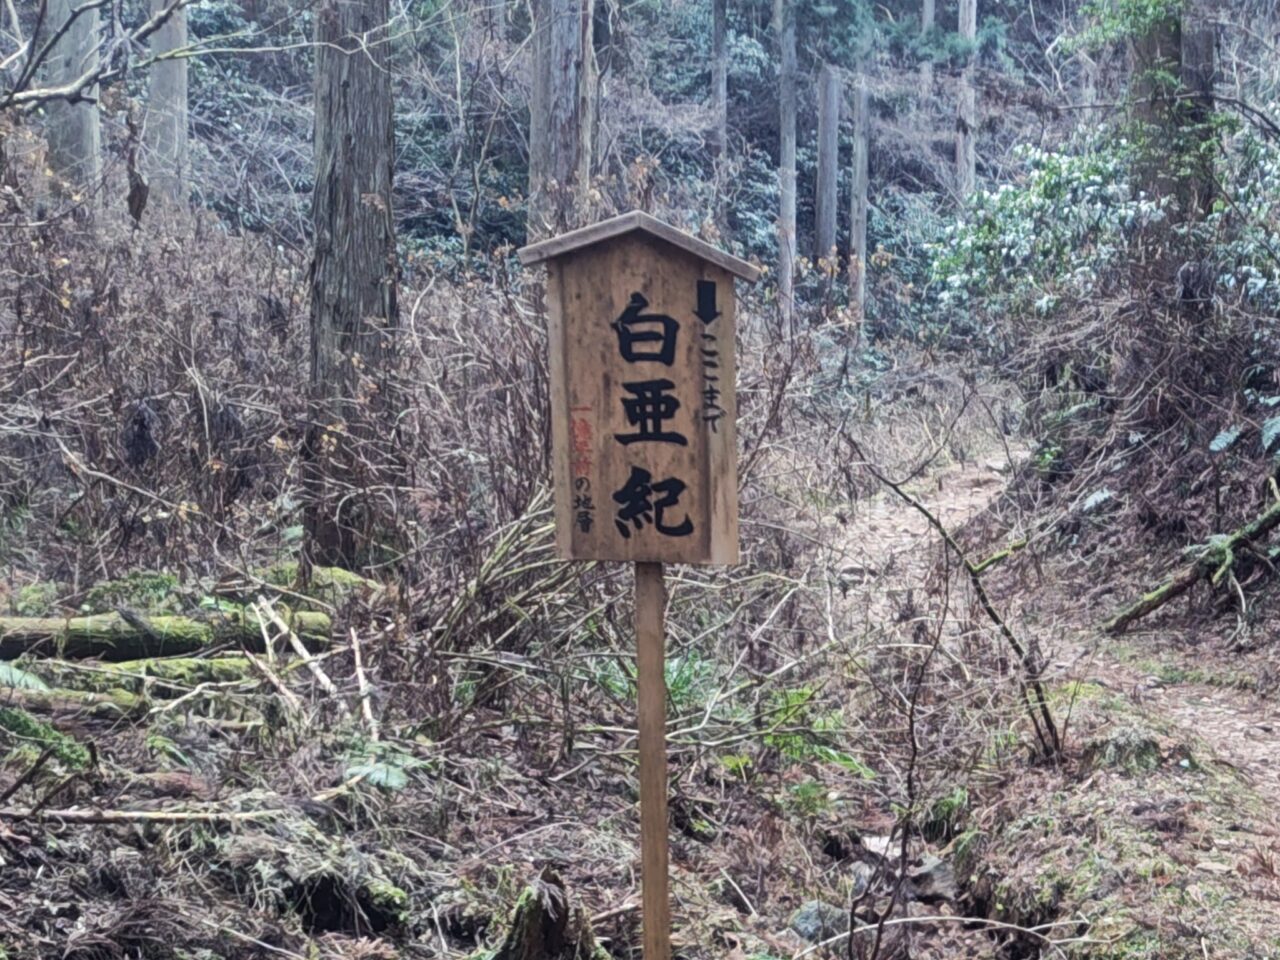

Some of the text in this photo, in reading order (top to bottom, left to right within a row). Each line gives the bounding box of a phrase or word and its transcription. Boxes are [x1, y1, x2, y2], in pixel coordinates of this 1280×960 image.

[610, 291, 694, 540] 白亜紀
[700, 334, 725, 433] ここまで
